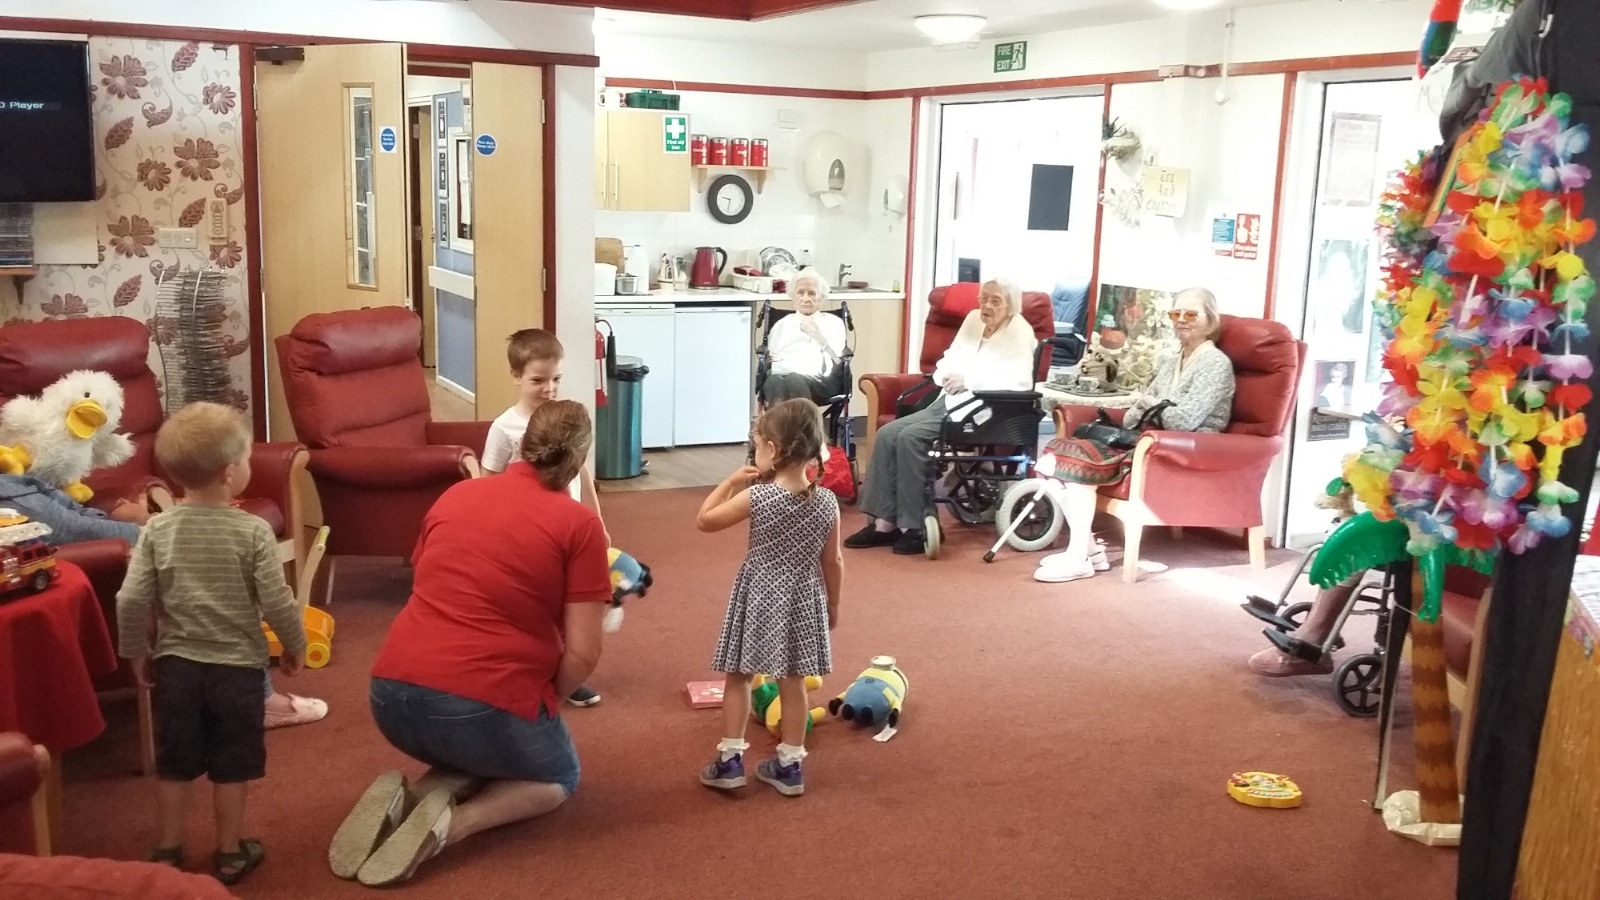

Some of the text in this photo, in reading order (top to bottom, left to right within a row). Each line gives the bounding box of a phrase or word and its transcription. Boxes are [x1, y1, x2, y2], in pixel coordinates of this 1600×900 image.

[997, 45, 1012, 56] FIRE
[996, 60, 1011, 71] EXIT
[9, 101, 45, 111] Player
[1160, 170, 1175, 183] Tea
[1158, 183, 1175, 198] And
